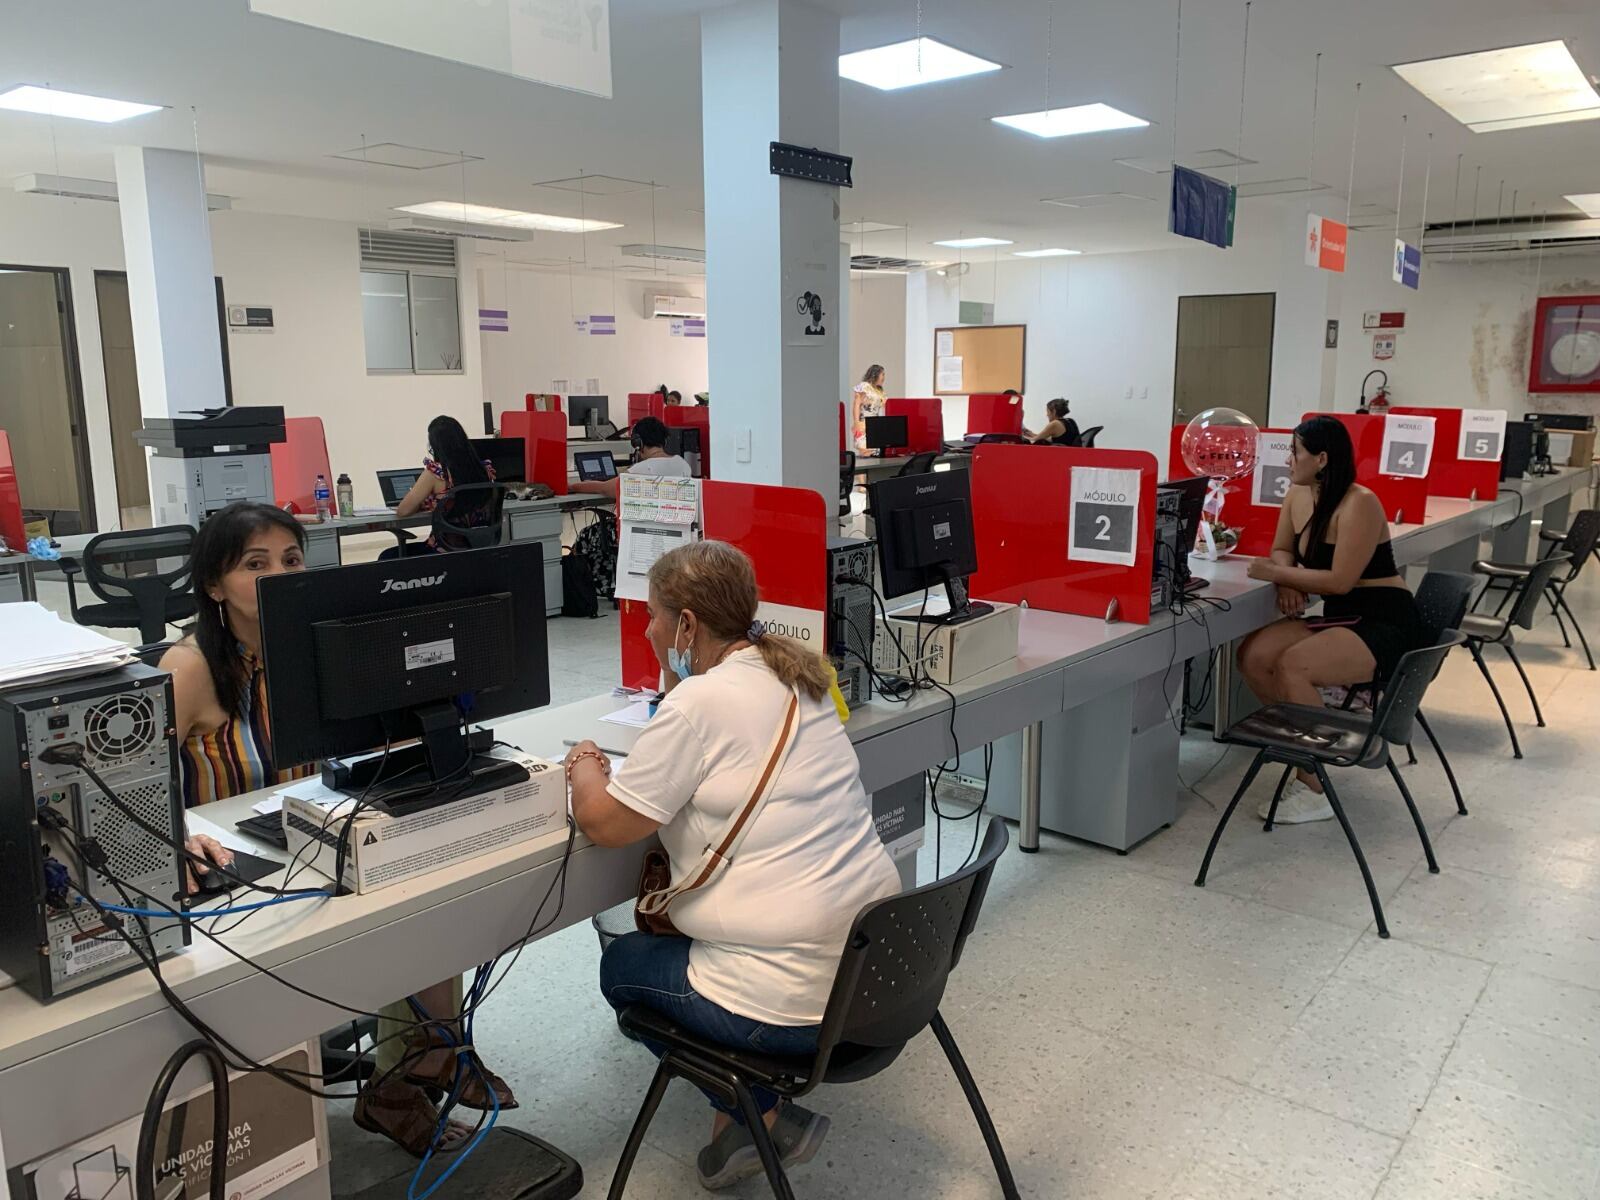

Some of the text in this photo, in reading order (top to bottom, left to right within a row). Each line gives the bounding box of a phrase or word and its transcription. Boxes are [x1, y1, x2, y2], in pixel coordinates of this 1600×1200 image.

[1270, 441, 1294, 451] MÓDU
[1474, 438, 1489, 454] 5
[1398, 450, 1415, 469] 4
[1083, 489, 1127, 503] MÓDULO
[1273, 476, 1292, 498] 3
[1094, 514, 1111, 541] 2
[380, 572, 447, 594] Janus
[161, 1122, 252, 1173] UNIDAD ARA
